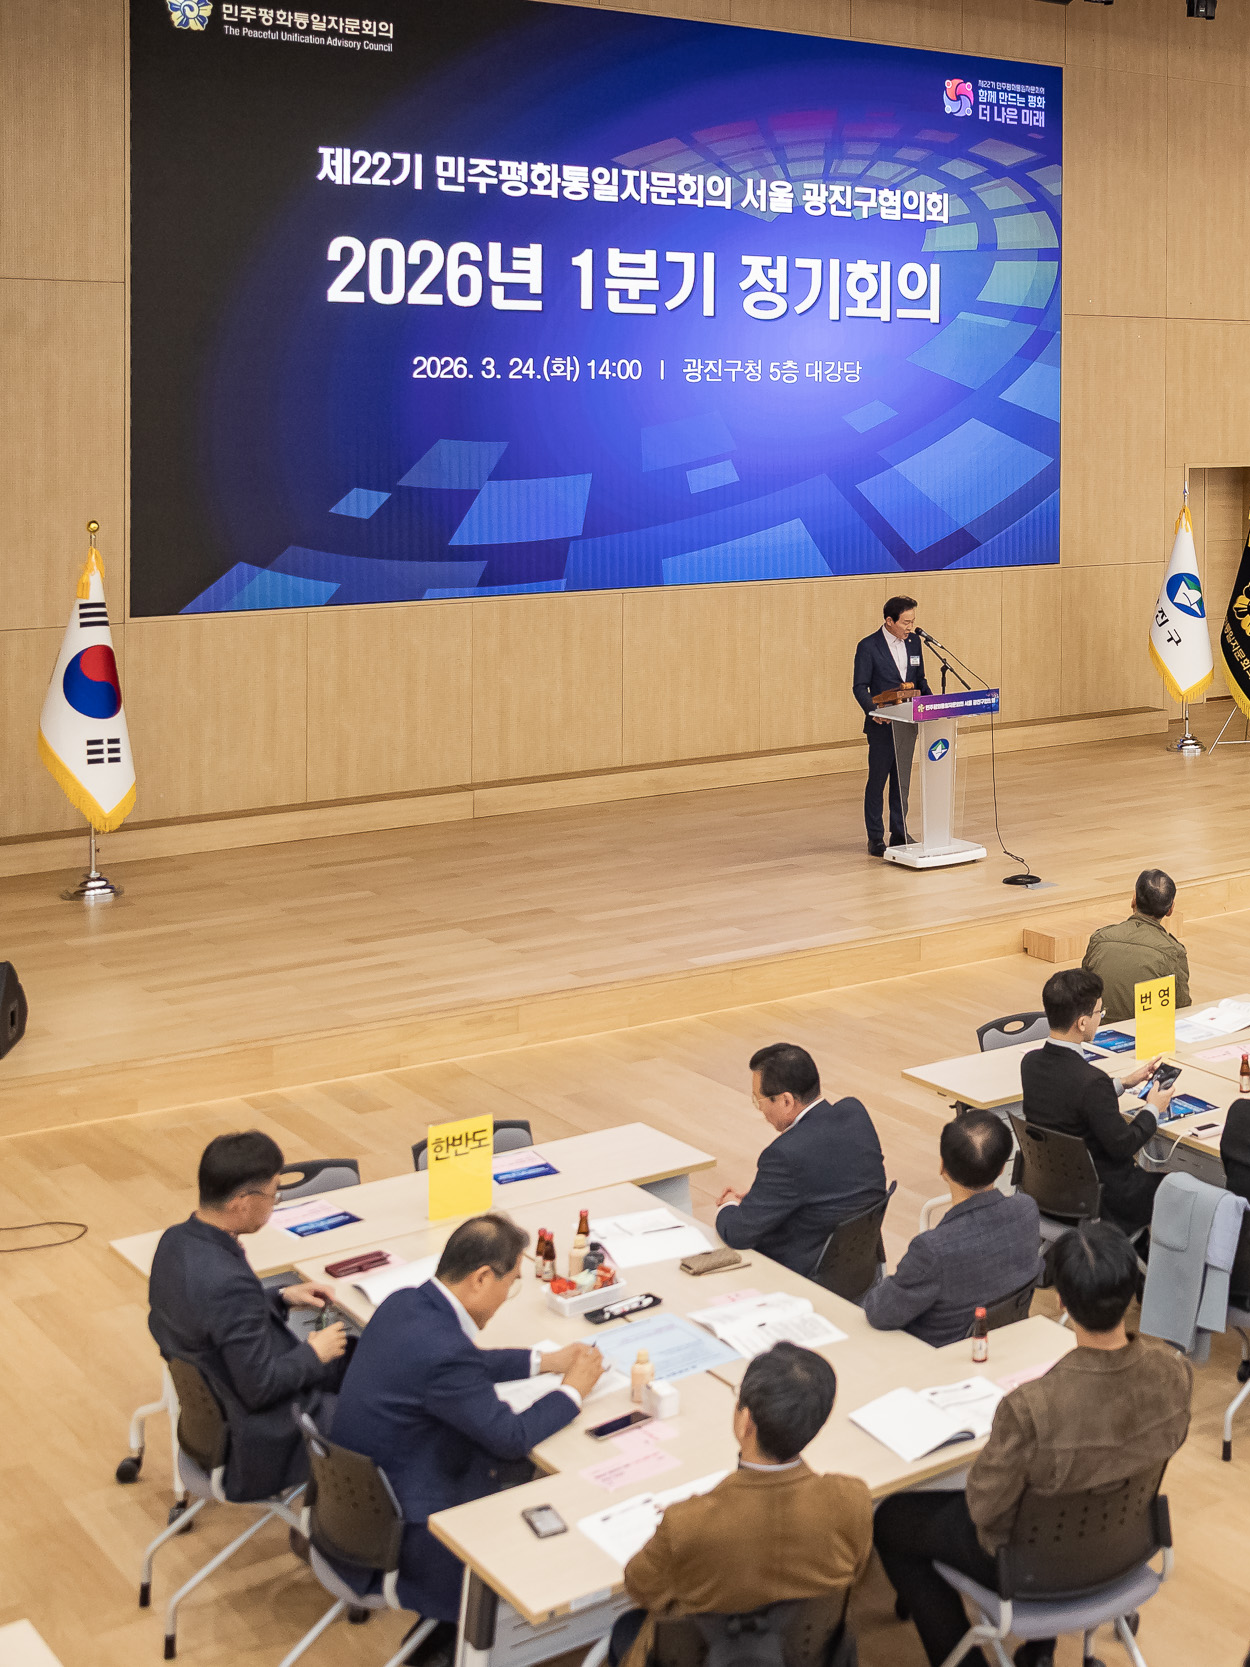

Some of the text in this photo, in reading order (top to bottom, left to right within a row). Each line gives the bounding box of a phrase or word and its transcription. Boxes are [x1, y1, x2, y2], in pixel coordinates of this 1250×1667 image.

[222, 3, 394, 38] 민주평화통일자문회의
[224, 25, 393, 52] The Peaceful Unification Advisory Council
[978, 89, 1046, 109] 함께 만드는 평화
[978, 104, 1045, 128] 더 나은 미래
[316, 146, 950, 224] 제22기 민주평화통일자문회의 서울 광진구협의회
[326, 235, 941, 324] 2026년 1분기 정기회의
[412, 355, 863, 384] 2026. 3. 24.(화) 14:00 광진구청 5층 대강당
[431, 1128, 491, 1161] 한반도
